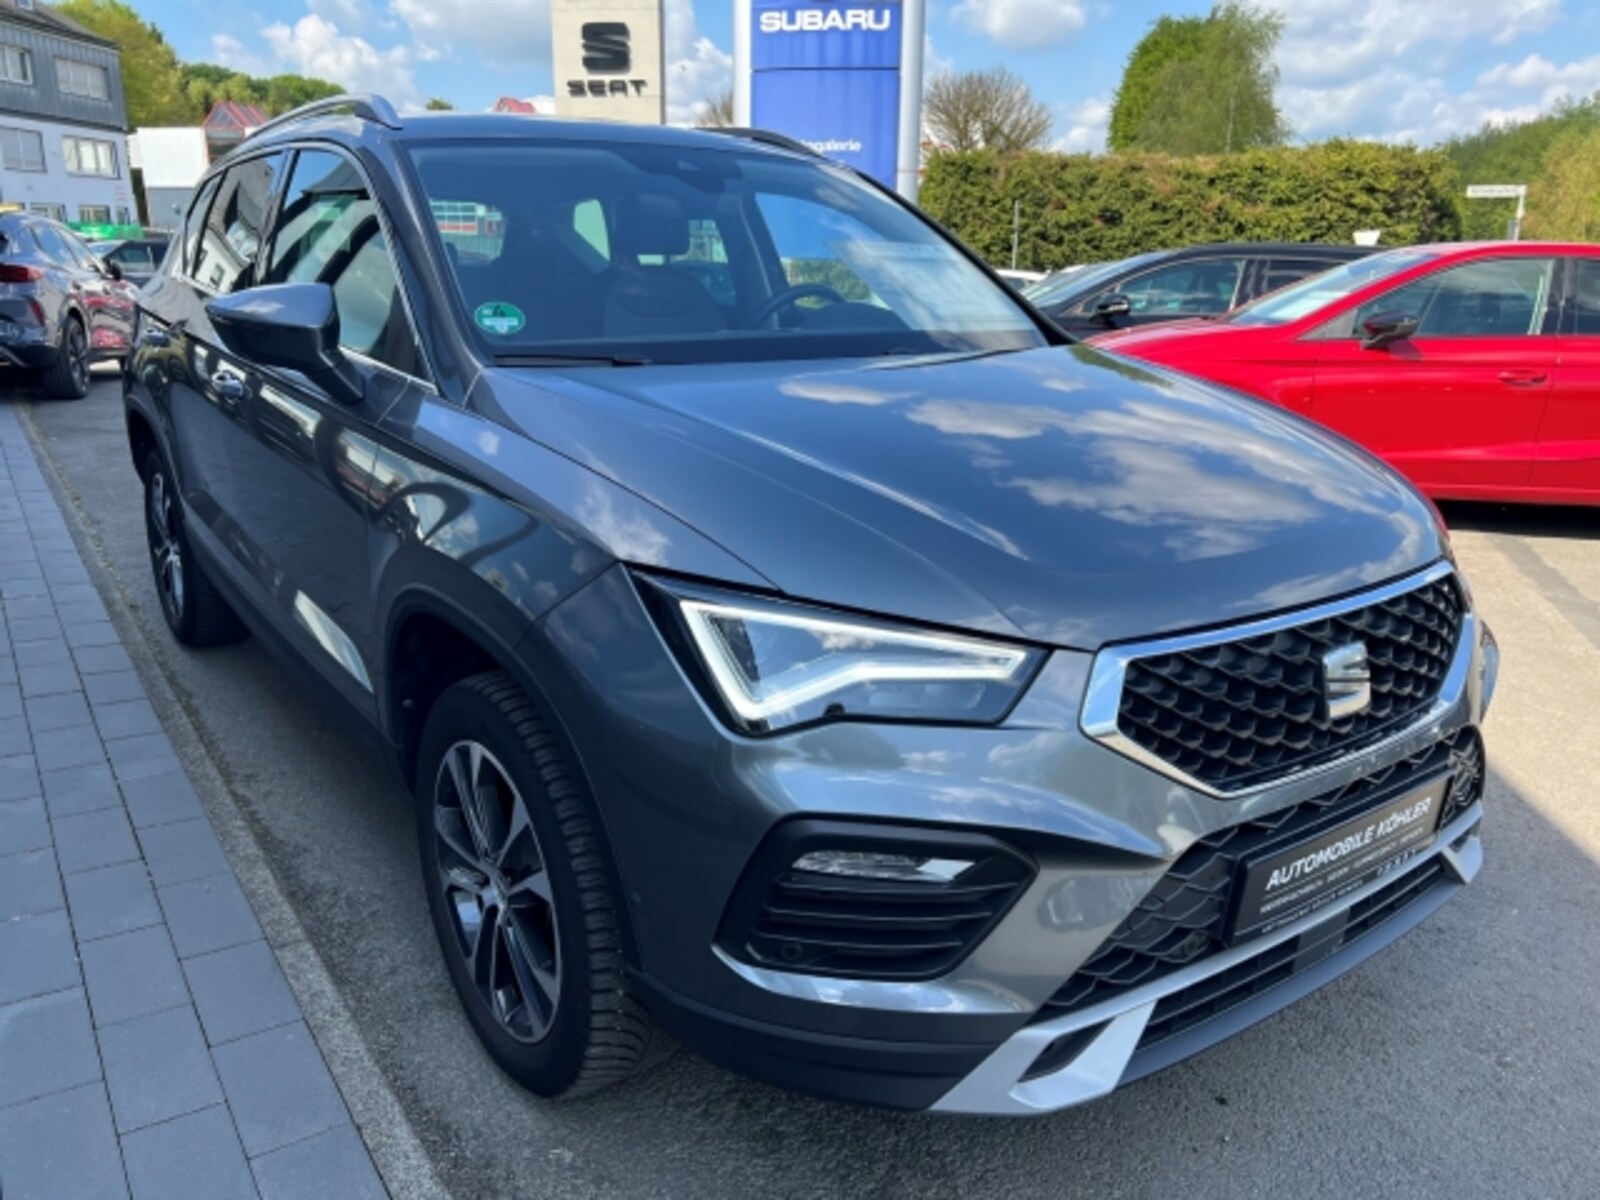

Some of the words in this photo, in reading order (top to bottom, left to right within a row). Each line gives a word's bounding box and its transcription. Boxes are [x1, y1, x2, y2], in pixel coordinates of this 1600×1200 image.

[759, 9, 891, 33] SUBARU
[567, 79, 648, 98] SEAT
[1265, 825, 1376, 890] AUTOMOBILE
[1376, 797, 1432, 838] KÖHLER
